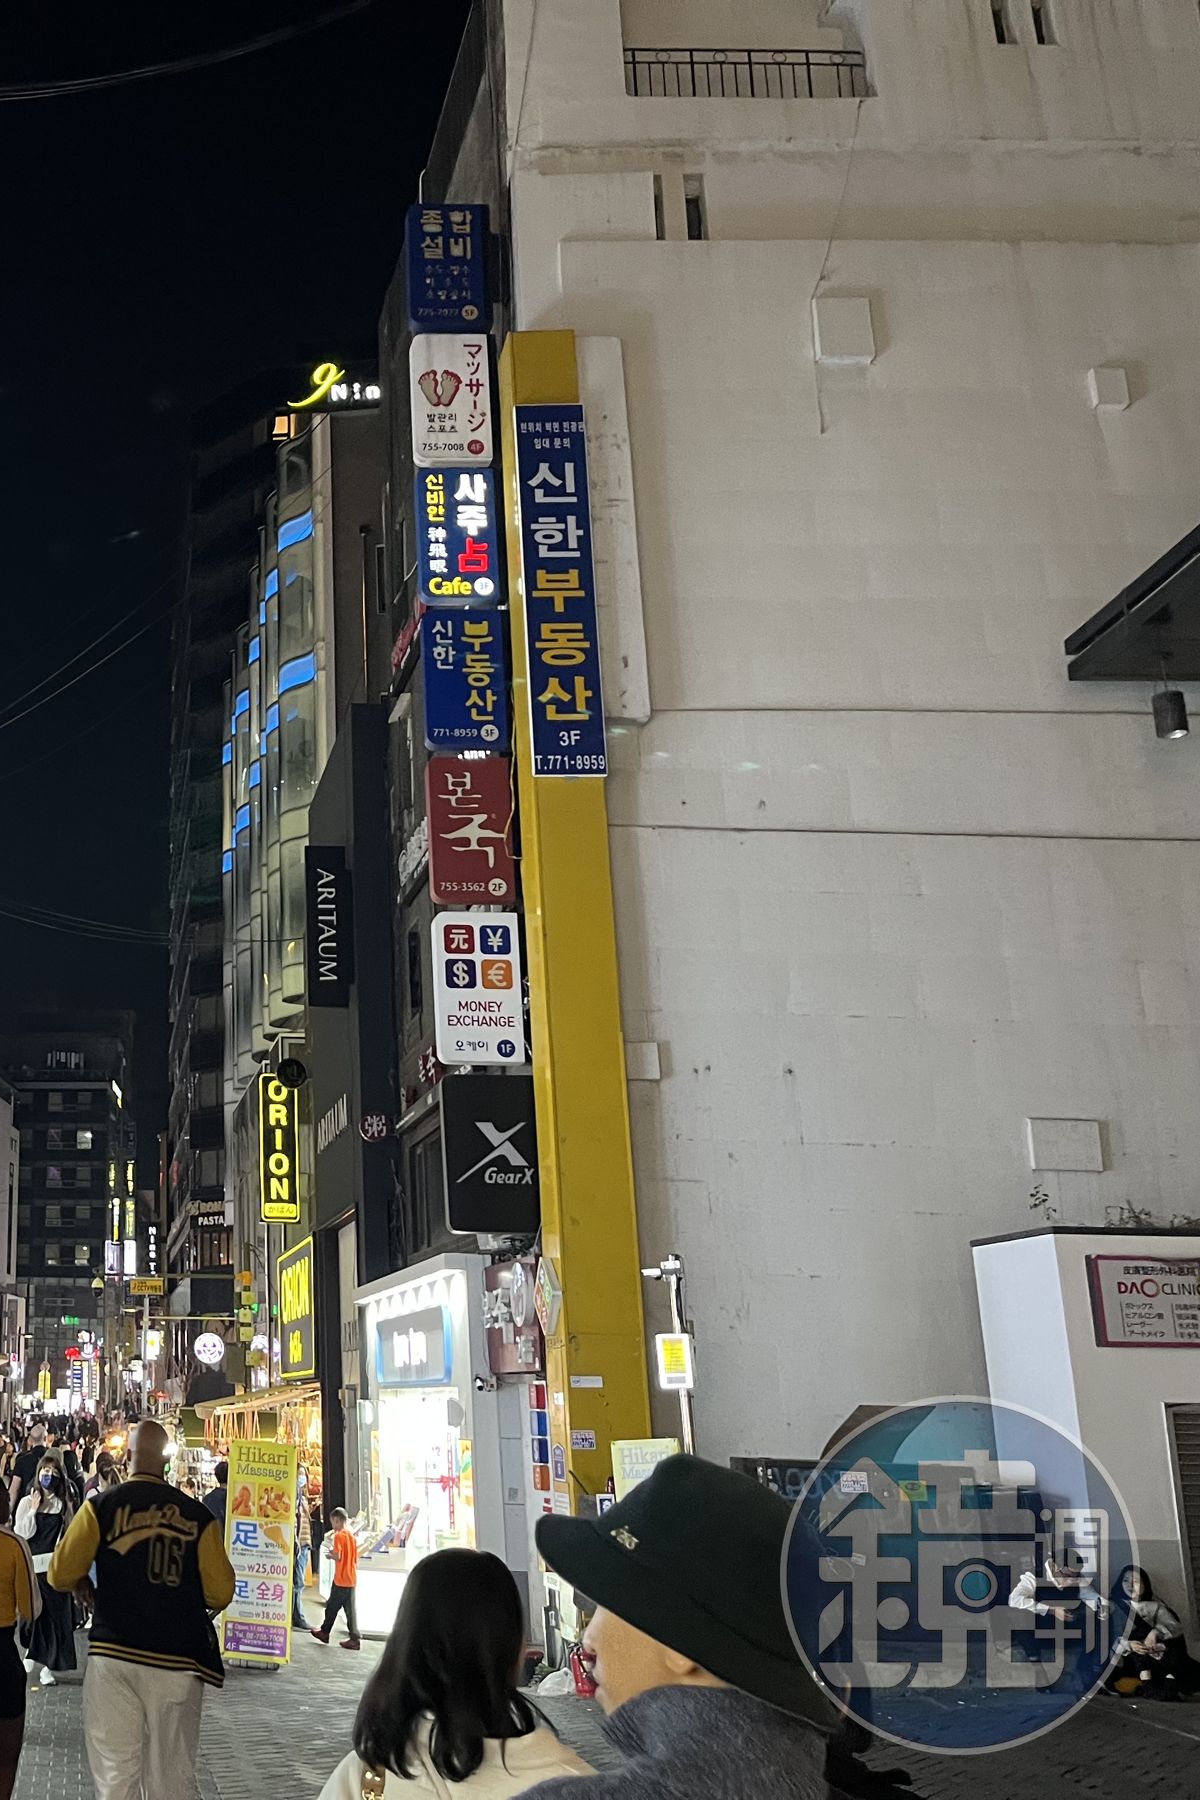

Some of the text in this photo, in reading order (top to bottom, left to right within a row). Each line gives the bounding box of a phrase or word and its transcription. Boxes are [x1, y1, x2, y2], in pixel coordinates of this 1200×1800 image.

[421, 235, 472, 260] 설비
[463, 344, 487, 432] マッサージ
[422, 442, 464, 451] 755-7008
[425, 474, 445, 522] 신비안
[428, 576, 472, 595] Cafe
[432, 620, 453, 669] 신한
[461, 620, 497, 721] 부동산
[433, 728, 496, 737] 771-8959 3F
[559, 731, 581, 746] 3F
[535, 754, 606, 771] T.771-8959
[437, 771, 507, 868] 본죽
[440, 882, 504, 892] 755-3562 2F
[316, 868, 338, 980] ARITAUM
[450, 929, 468, 949] 元
[458, 1001, 502, 1012] MONEY
[448, 1015, 515, 1027] EXCHANGE
[455, 1040, 513, 1053] 오케이 1F
[267, 1080, 290, 1200] ORION
[484, 1167, 534, 1185] GearX
[280, 1256, 309, 1325] ORION
[237, 1446, 288, 1466] Hikari
[236, 1462, 288, 1481] Massage
[232, 1522, 259, 1548] 足
[256, 1581, 285, 1602] 全身
[225, 1642, 237, 1651] 4F
